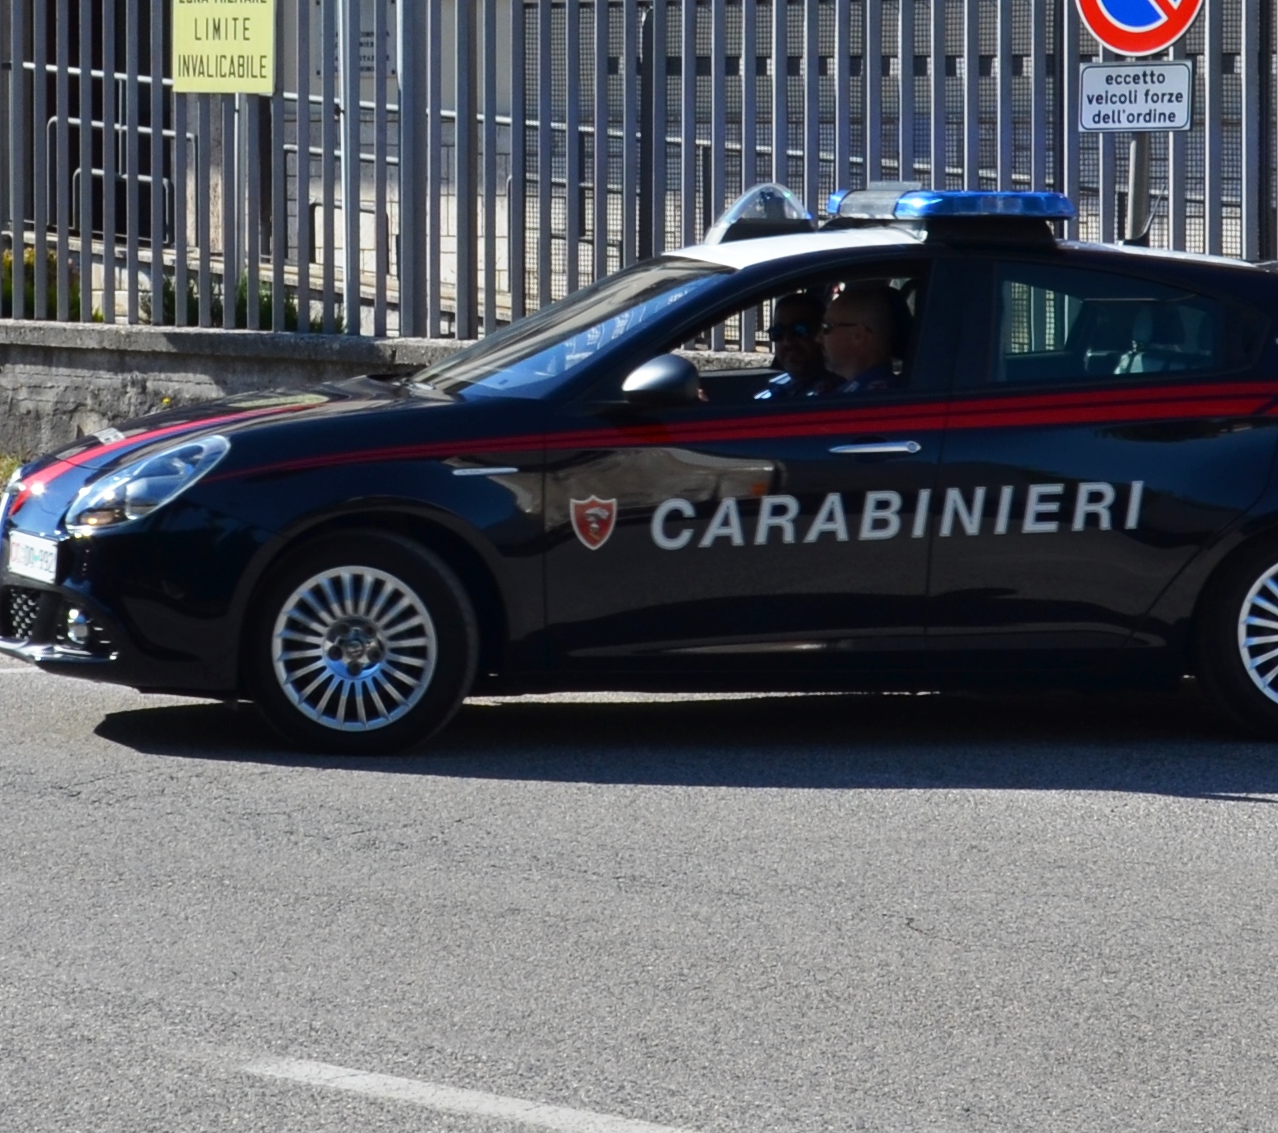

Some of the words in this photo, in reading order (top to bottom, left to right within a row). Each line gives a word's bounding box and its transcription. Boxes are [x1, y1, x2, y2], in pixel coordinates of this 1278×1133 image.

[194, 17, 251, 41] LIMITE
[178, 54, 268, 79] INVALICABILE
[1105, 70, 1166, 85] eccetto
[1086, 89, 1138, 105] veicoli
[1144, 88, 1184, 104] forze
[1092, 108, 1176, 124] dell'ordine
[650, 479, 1145, 551] CARABINIERI
